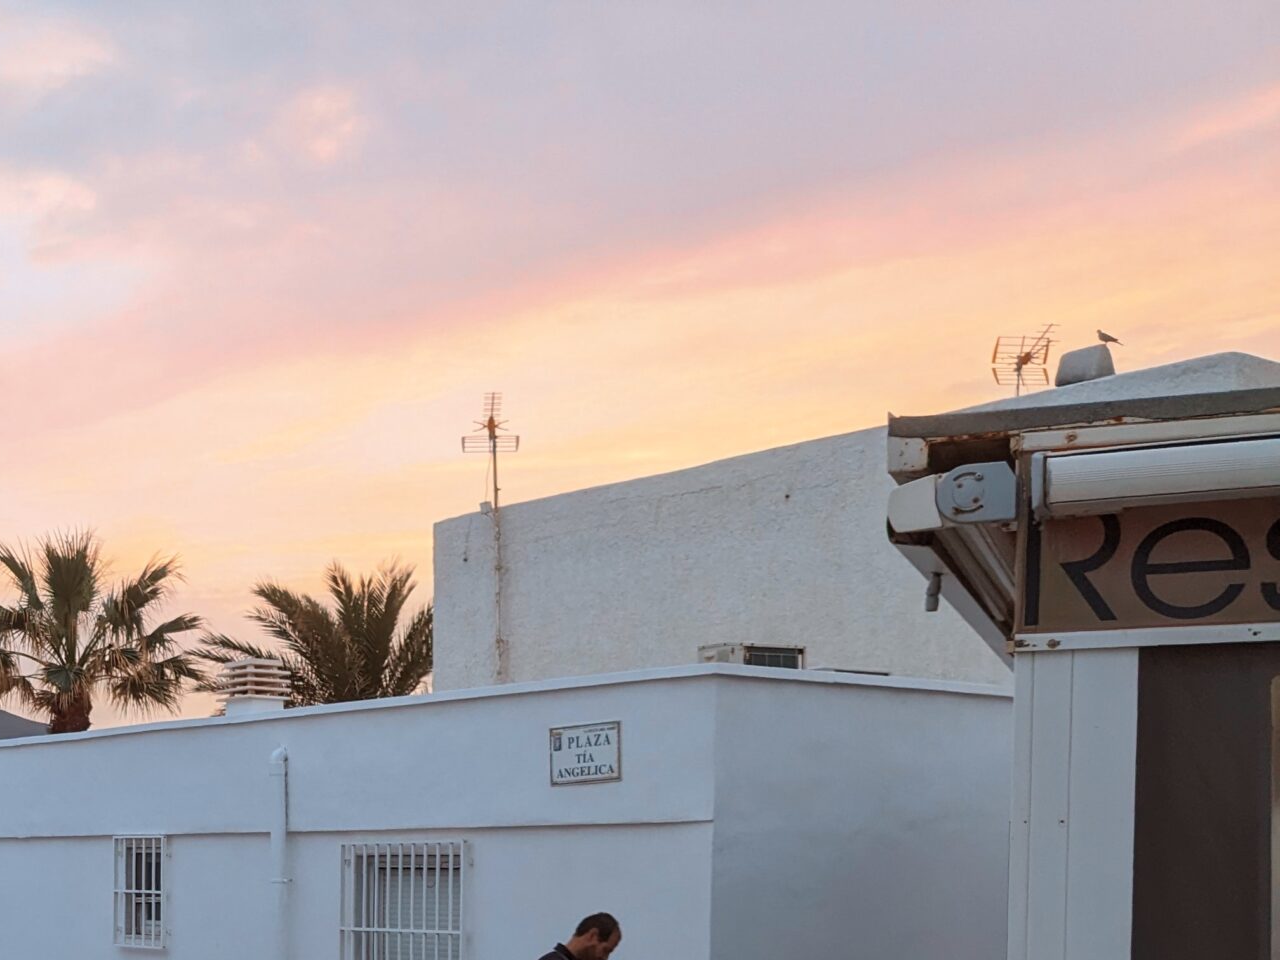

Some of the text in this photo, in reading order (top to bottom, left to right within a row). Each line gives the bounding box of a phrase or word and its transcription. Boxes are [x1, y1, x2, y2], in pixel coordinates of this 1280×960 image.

[1024, 511, 1280, 626] Re
[567, 732, 611, 749] PLAZA
[575, 750, 595, 764] TÍA
[557, 764, 615, 779] ANGELICA
